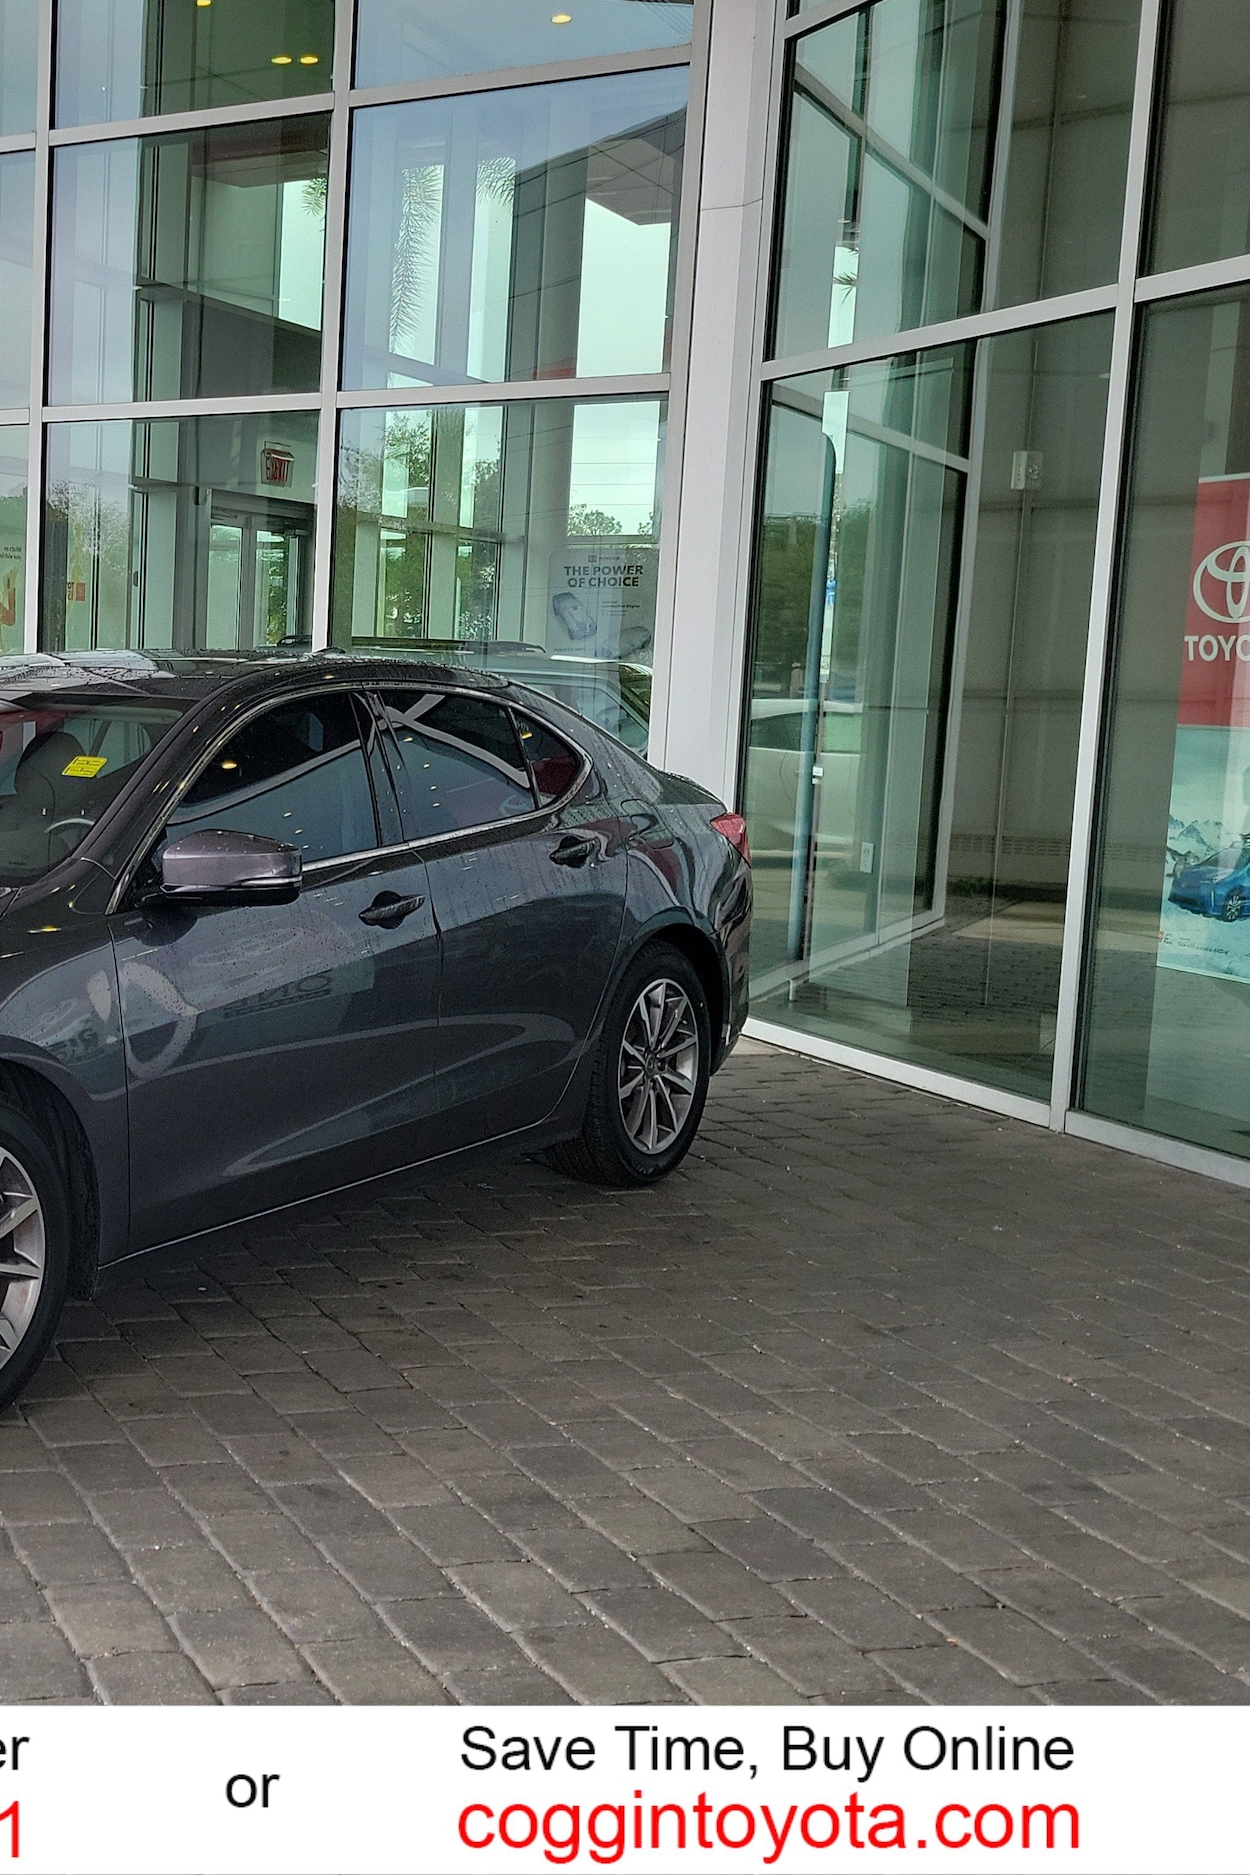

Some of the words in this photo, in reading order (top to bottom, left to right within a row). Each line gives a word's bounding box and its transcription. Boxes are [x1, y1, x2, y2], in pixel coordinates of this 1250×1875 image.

[564, 566, 589, 576] THE
[593, 565, 644, 575] POWER
[567, 578, 585, 588] OF
[588, 577, 639, 587] CHOICE
[1183, 634, 1250, 662] TOYO
